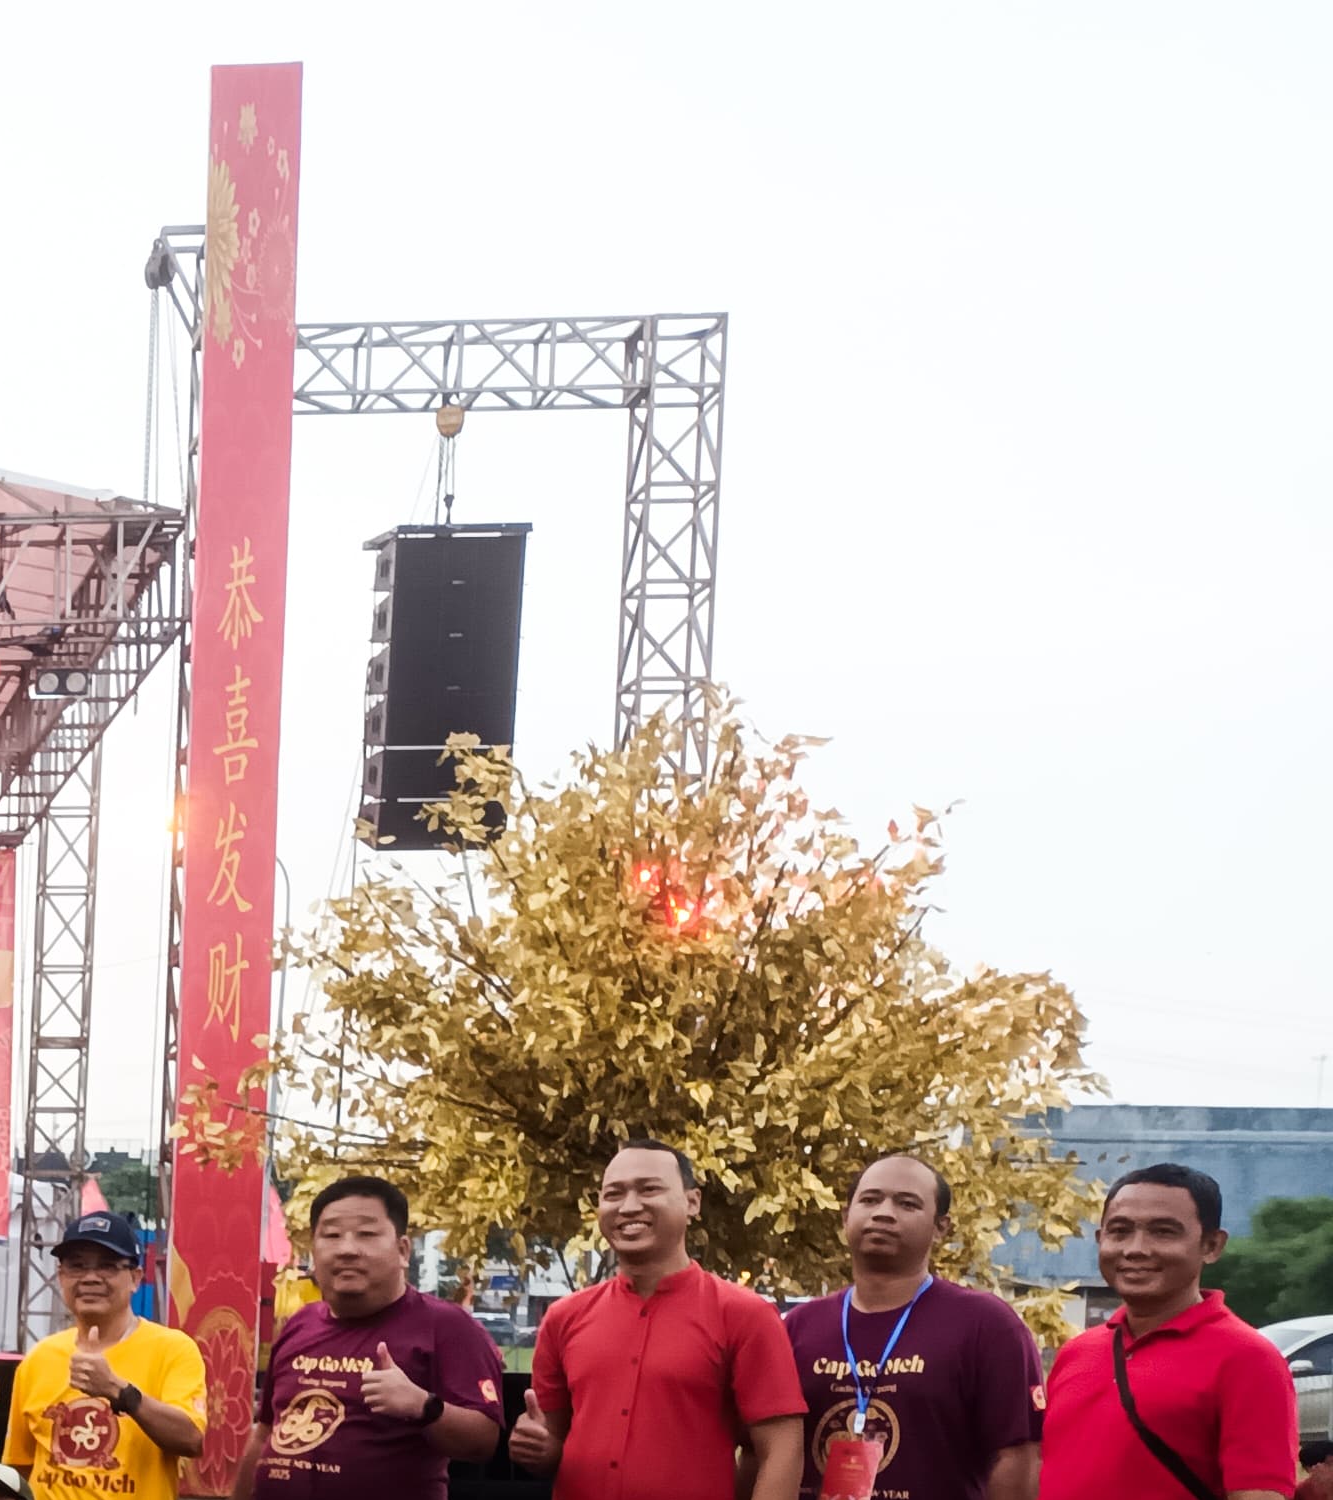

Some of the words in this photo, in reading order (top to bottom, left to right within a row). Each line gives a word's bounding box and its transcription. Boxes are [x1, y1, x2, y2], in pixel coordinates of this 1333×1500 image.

[202, 537, 263, 1043] 恭喜发财
[813, 1358, 850, 1380] Cap
[316, 1462, 341, 1474] YEAR
[91, 1473, 135, 1494] Meh
[884, 1490, 910, 1500] YEAR
